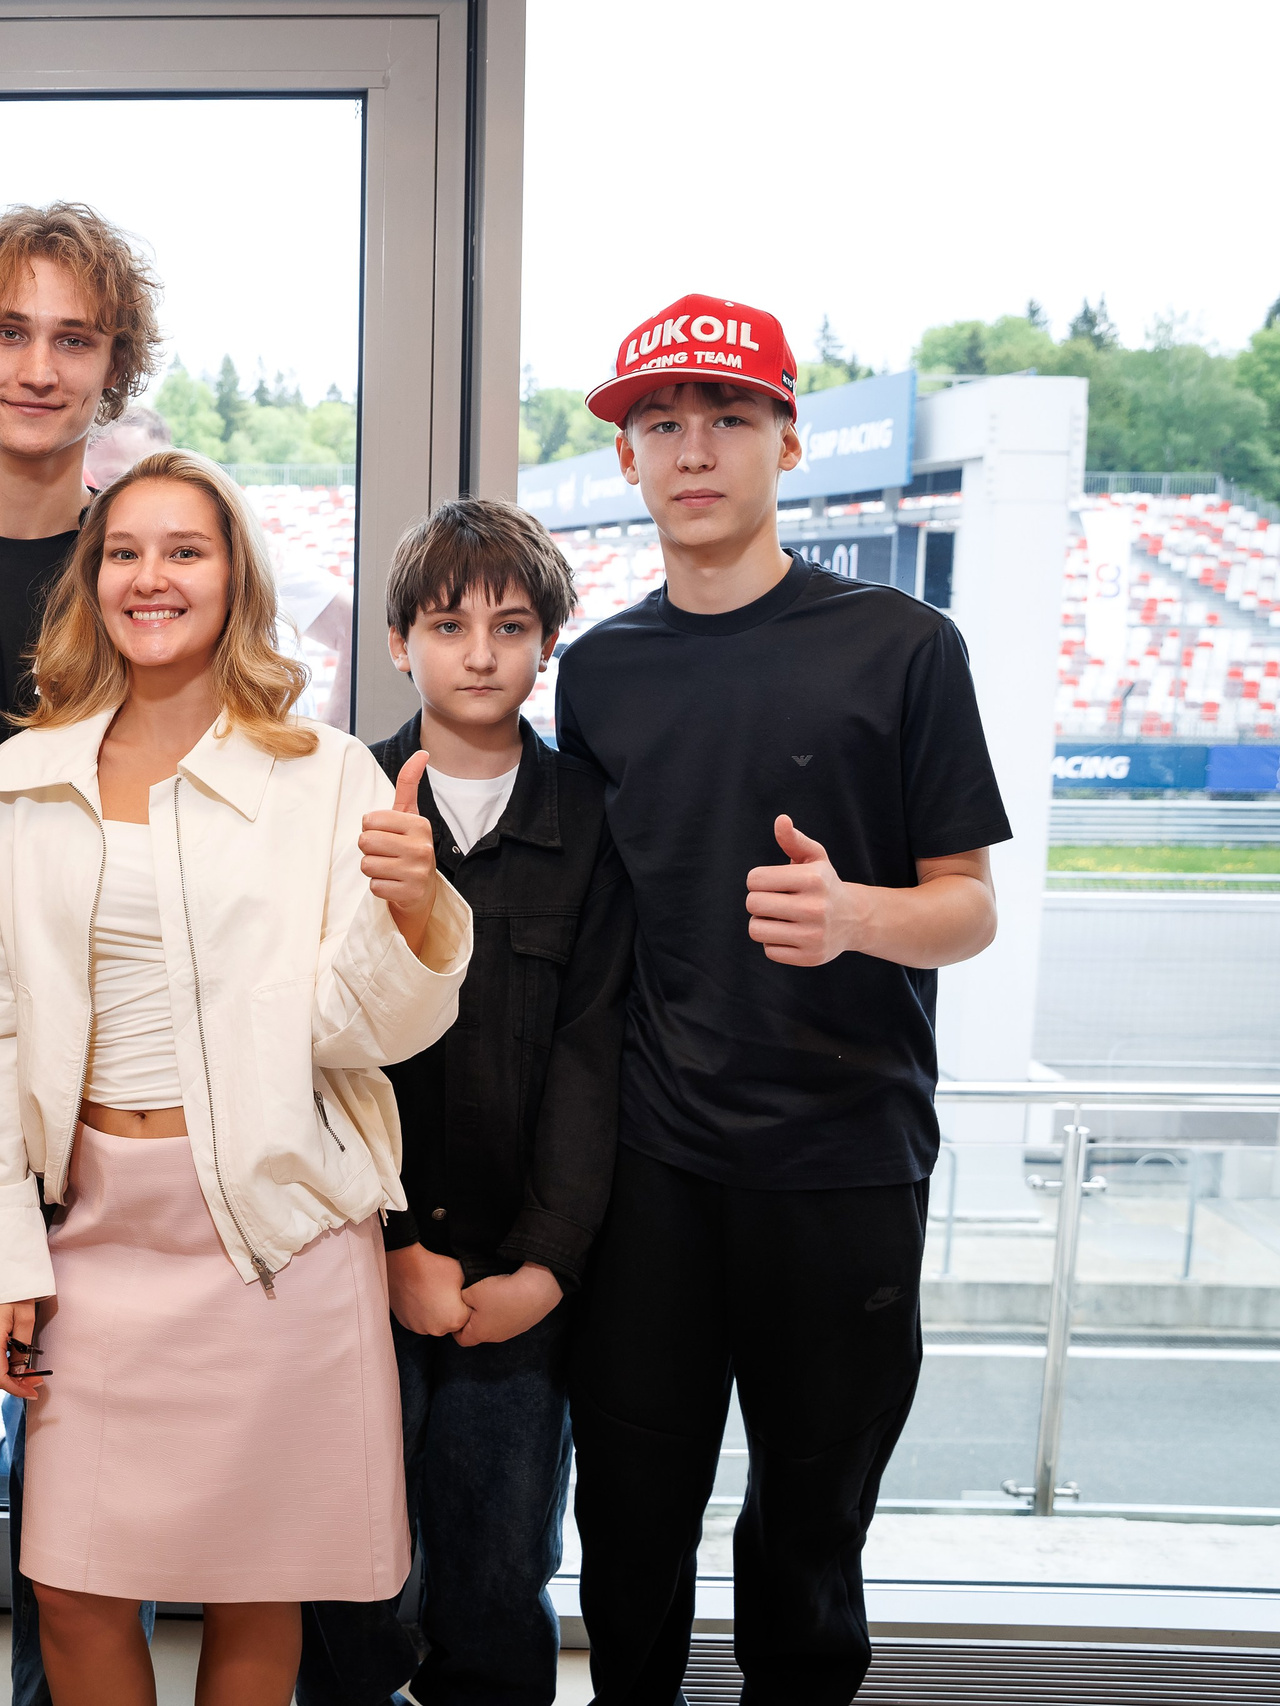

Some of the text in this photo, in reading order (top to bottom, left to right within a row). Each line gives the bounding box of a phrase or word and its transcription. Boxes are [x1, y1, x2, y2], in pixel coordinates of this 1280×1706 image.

[625, 315, 759, 366] LUKOIL
[632, 351, 742, 372] ACING TEAM
